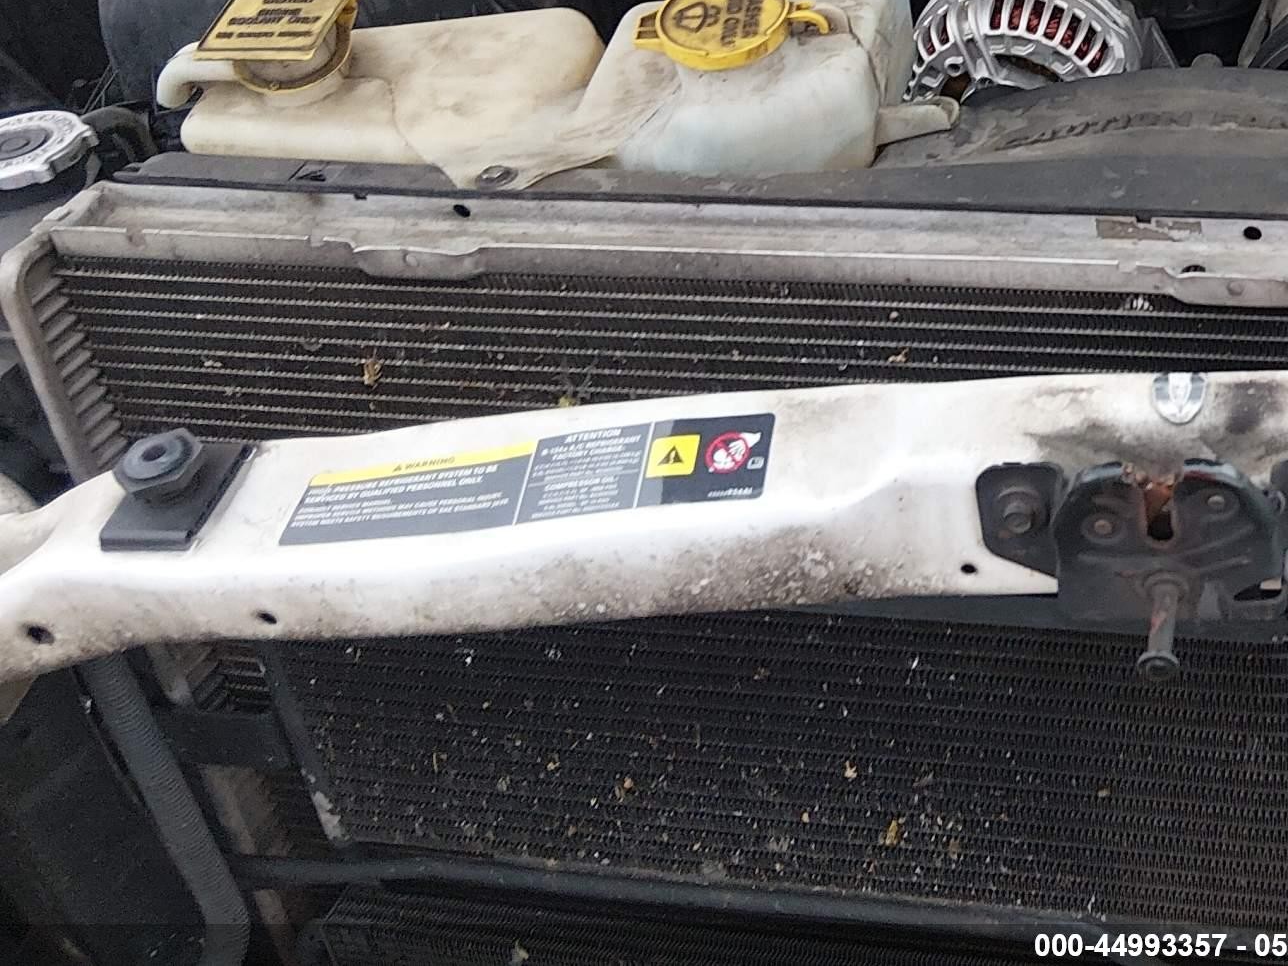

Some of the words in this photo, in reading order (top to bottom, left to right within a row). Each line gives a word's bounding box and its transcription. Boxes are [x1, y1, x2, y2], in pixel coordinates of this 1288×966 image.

[227, 16, 284, 26] COOLANT
[286, 15, 323, 25] ONLY
[719, 17, 740, 47] ONLY
[563, 428, 622, 444] ATTENTION
[585, 434, 642, 449] REFRIGERANT
[404, 456, 456, 471] WARNING
[379, 472, 437, 488] REFRIGERANT
[437, 467, 474, 481] SYSTEM
[473, 465, 486, 475] TO
[485, 464, 499, 474] BE
[304, 493, 348, 504] SERVICED
[346, 491, 360, 500] BY
[360, 485, 406, 498] QUALIFIED
[406, 478, 457, 492] PERSONNEL
